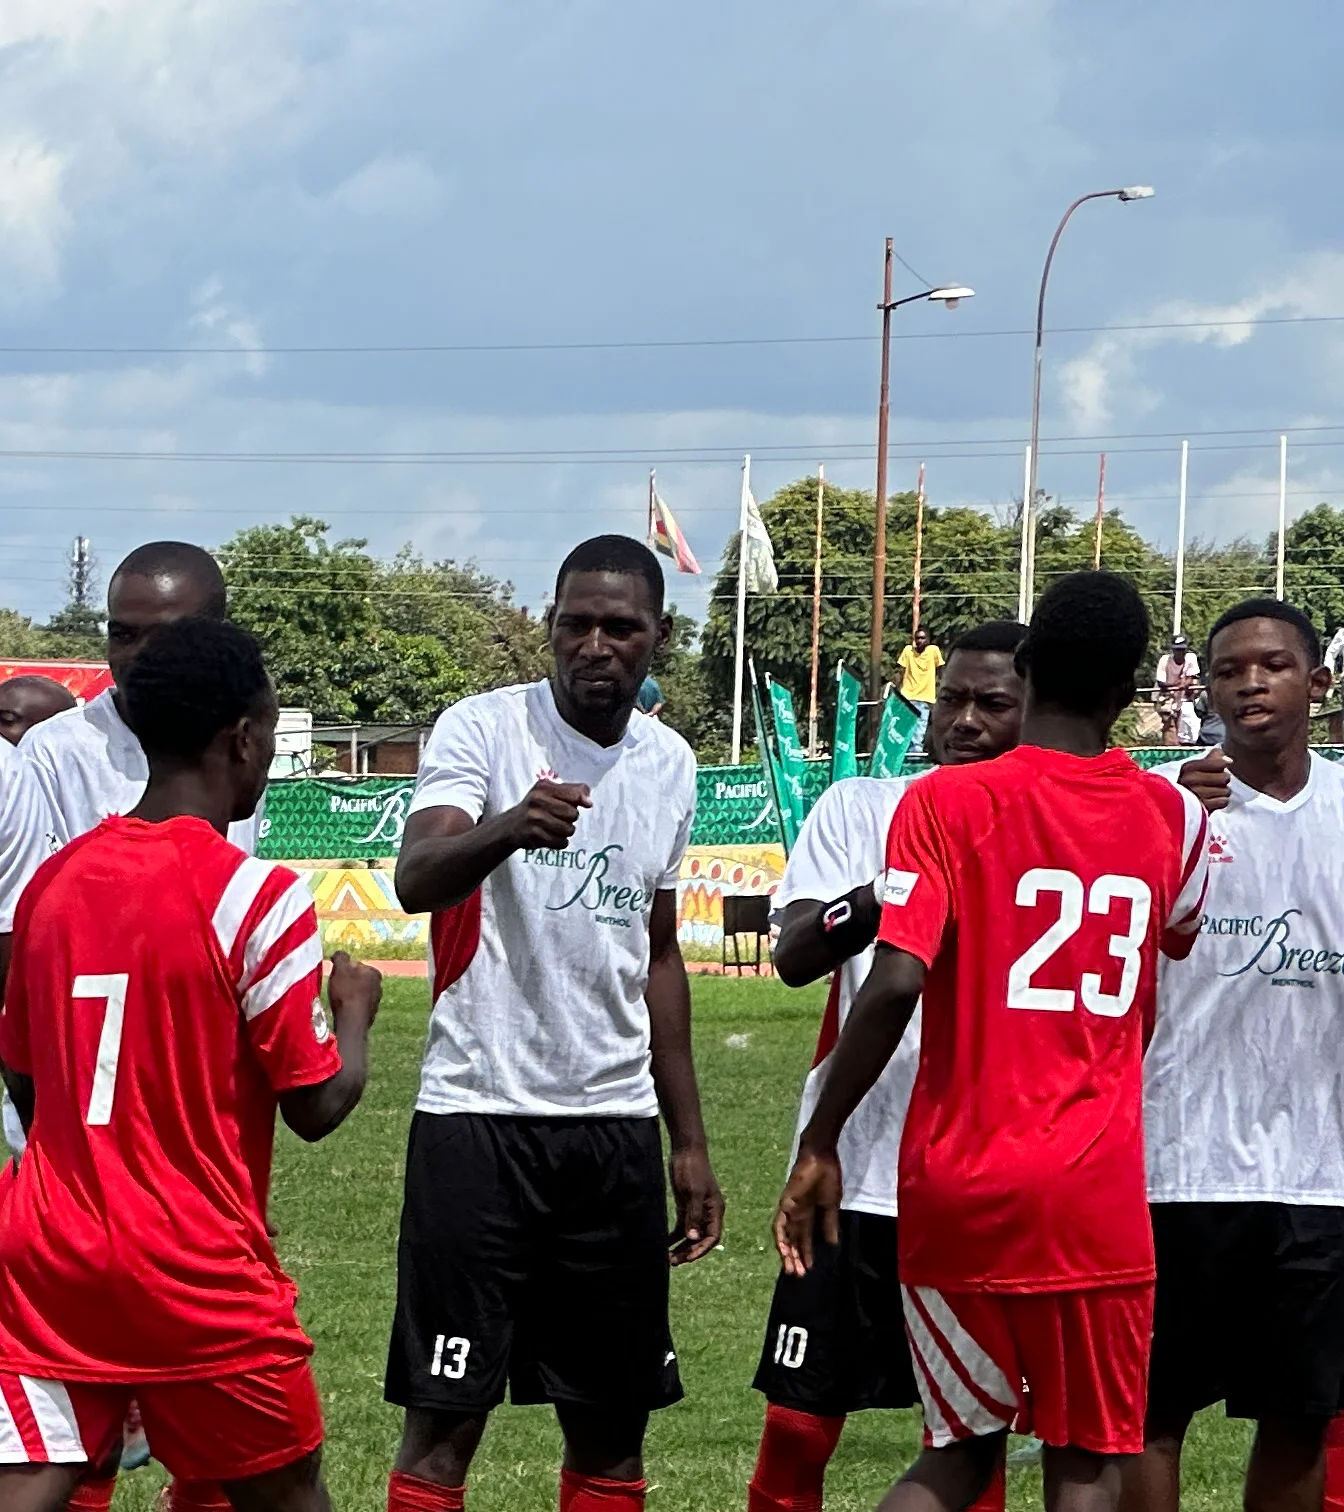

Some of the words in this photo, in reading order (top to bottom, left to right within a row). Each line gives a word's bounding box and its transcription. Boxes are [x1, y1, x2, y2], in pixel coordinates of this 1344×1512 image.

[716, 781, 768, 799] PACIFIC
[331, 795, 383, 813] PACIFIC
[523, 848, 586, 870] PACIFIC
[1200, 916, 1263, 937] PACIFIC
[1006, 868, 1152, 1018] 23
[1271, 977, 1316, 988] MENTHOL
[72, 973, 129, 1126] 7
[430, 1334, 471, 1380] 13
[773, 1324, 808, 1369] 10
